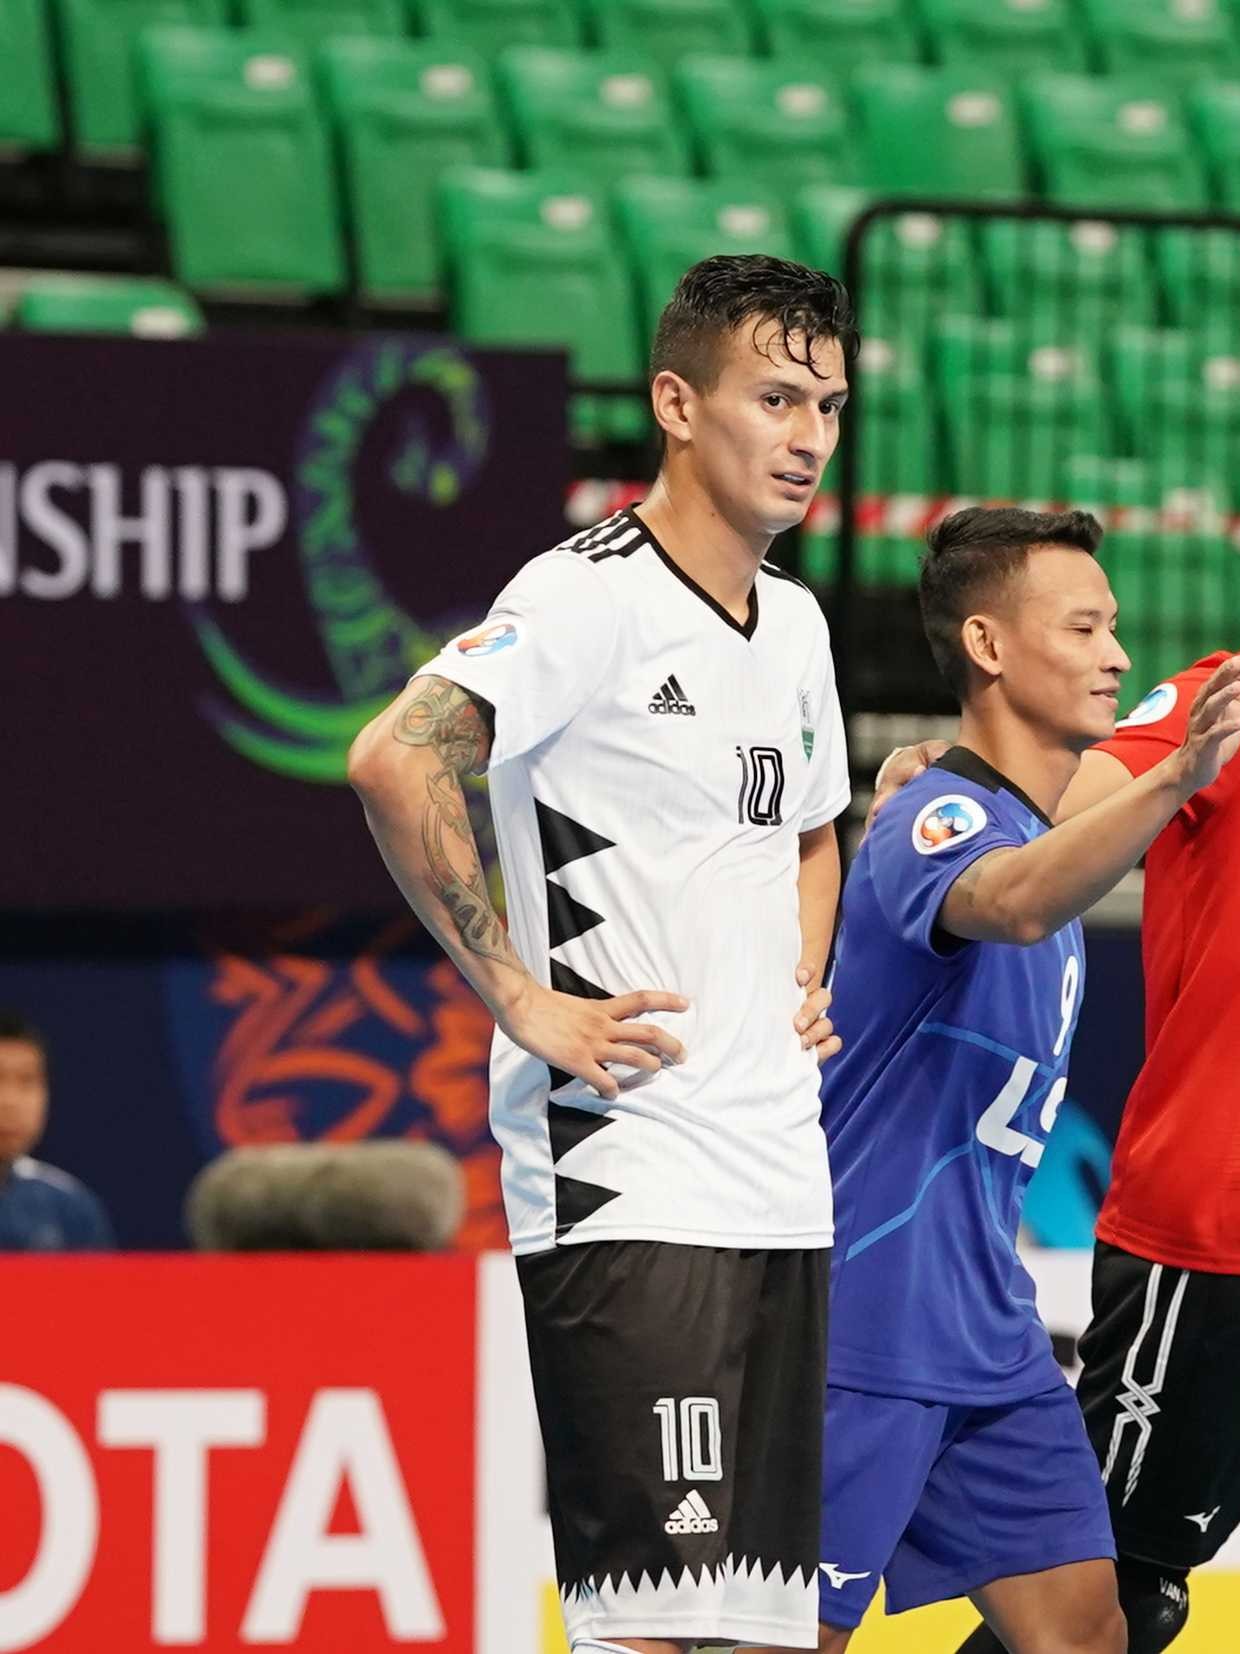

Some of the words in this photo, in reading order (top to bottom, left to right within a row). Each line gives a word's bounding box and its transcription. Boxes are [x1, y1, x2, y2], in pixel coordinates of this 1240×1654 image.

[648, 700, 696, 717] adidas
[735, 745, 785, 826] 10
[1053, 955, 1079, 1056] 9
[652, 1397, 724, 1482] 10
[664, 1517, 719, 1535] adidas
